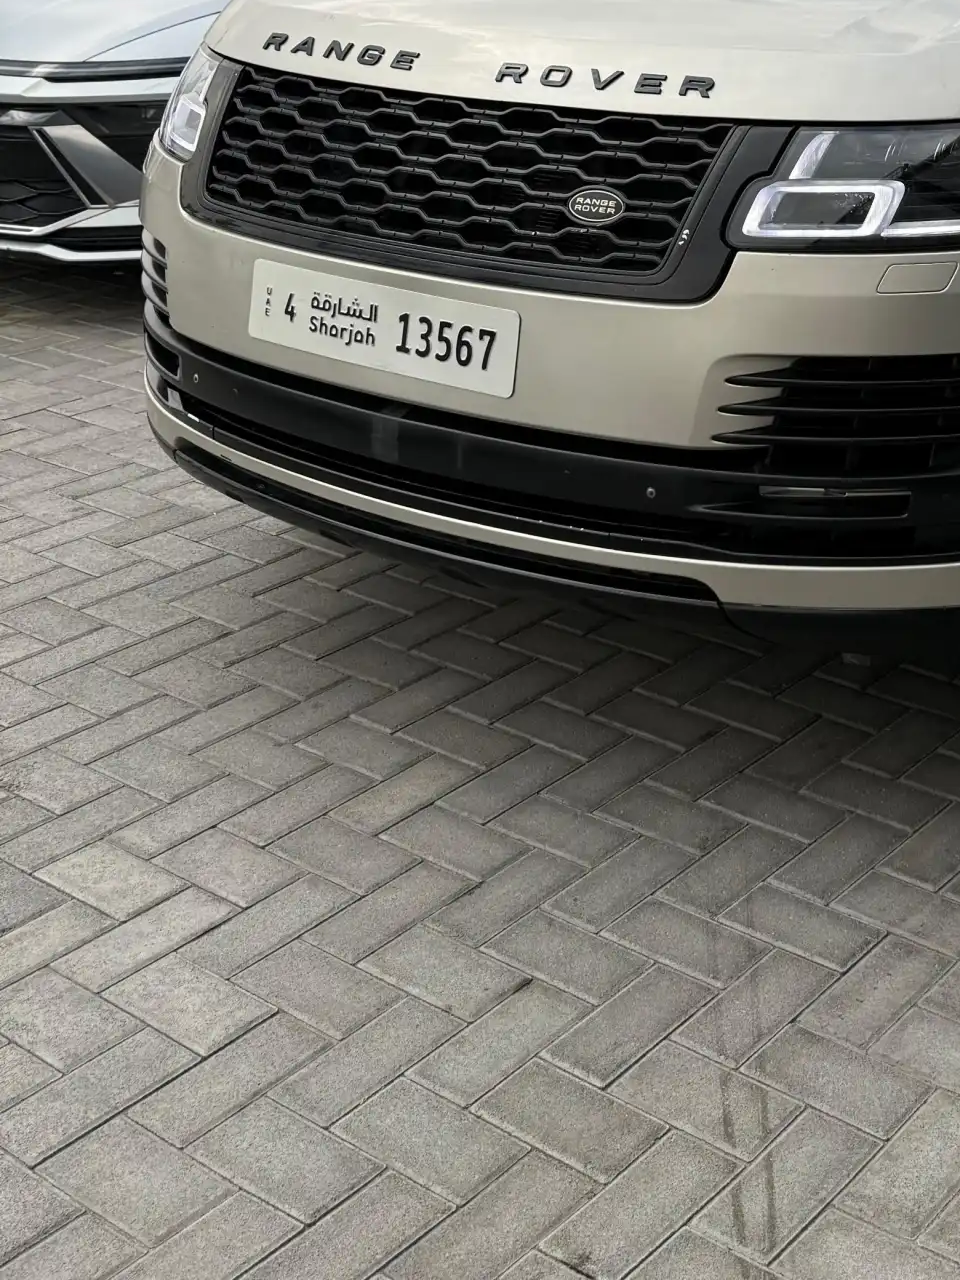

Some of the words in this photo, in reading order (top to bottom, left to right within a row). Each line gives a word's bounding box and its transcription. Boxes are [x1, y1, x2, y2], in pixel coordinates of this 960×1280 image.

[262, 32, 421, 71] RANGE
[494, 62, 716, 99] ROVER
[574, 204, 616, 214] ROVER
[575, 197, 617, 207] RANGE
[284, 292, 296, 322] 4
[310, 291, 378, 322] الشارقة
[309, 316, 376, 346] Sharjah
[395, 312, 498, 372] 13567
